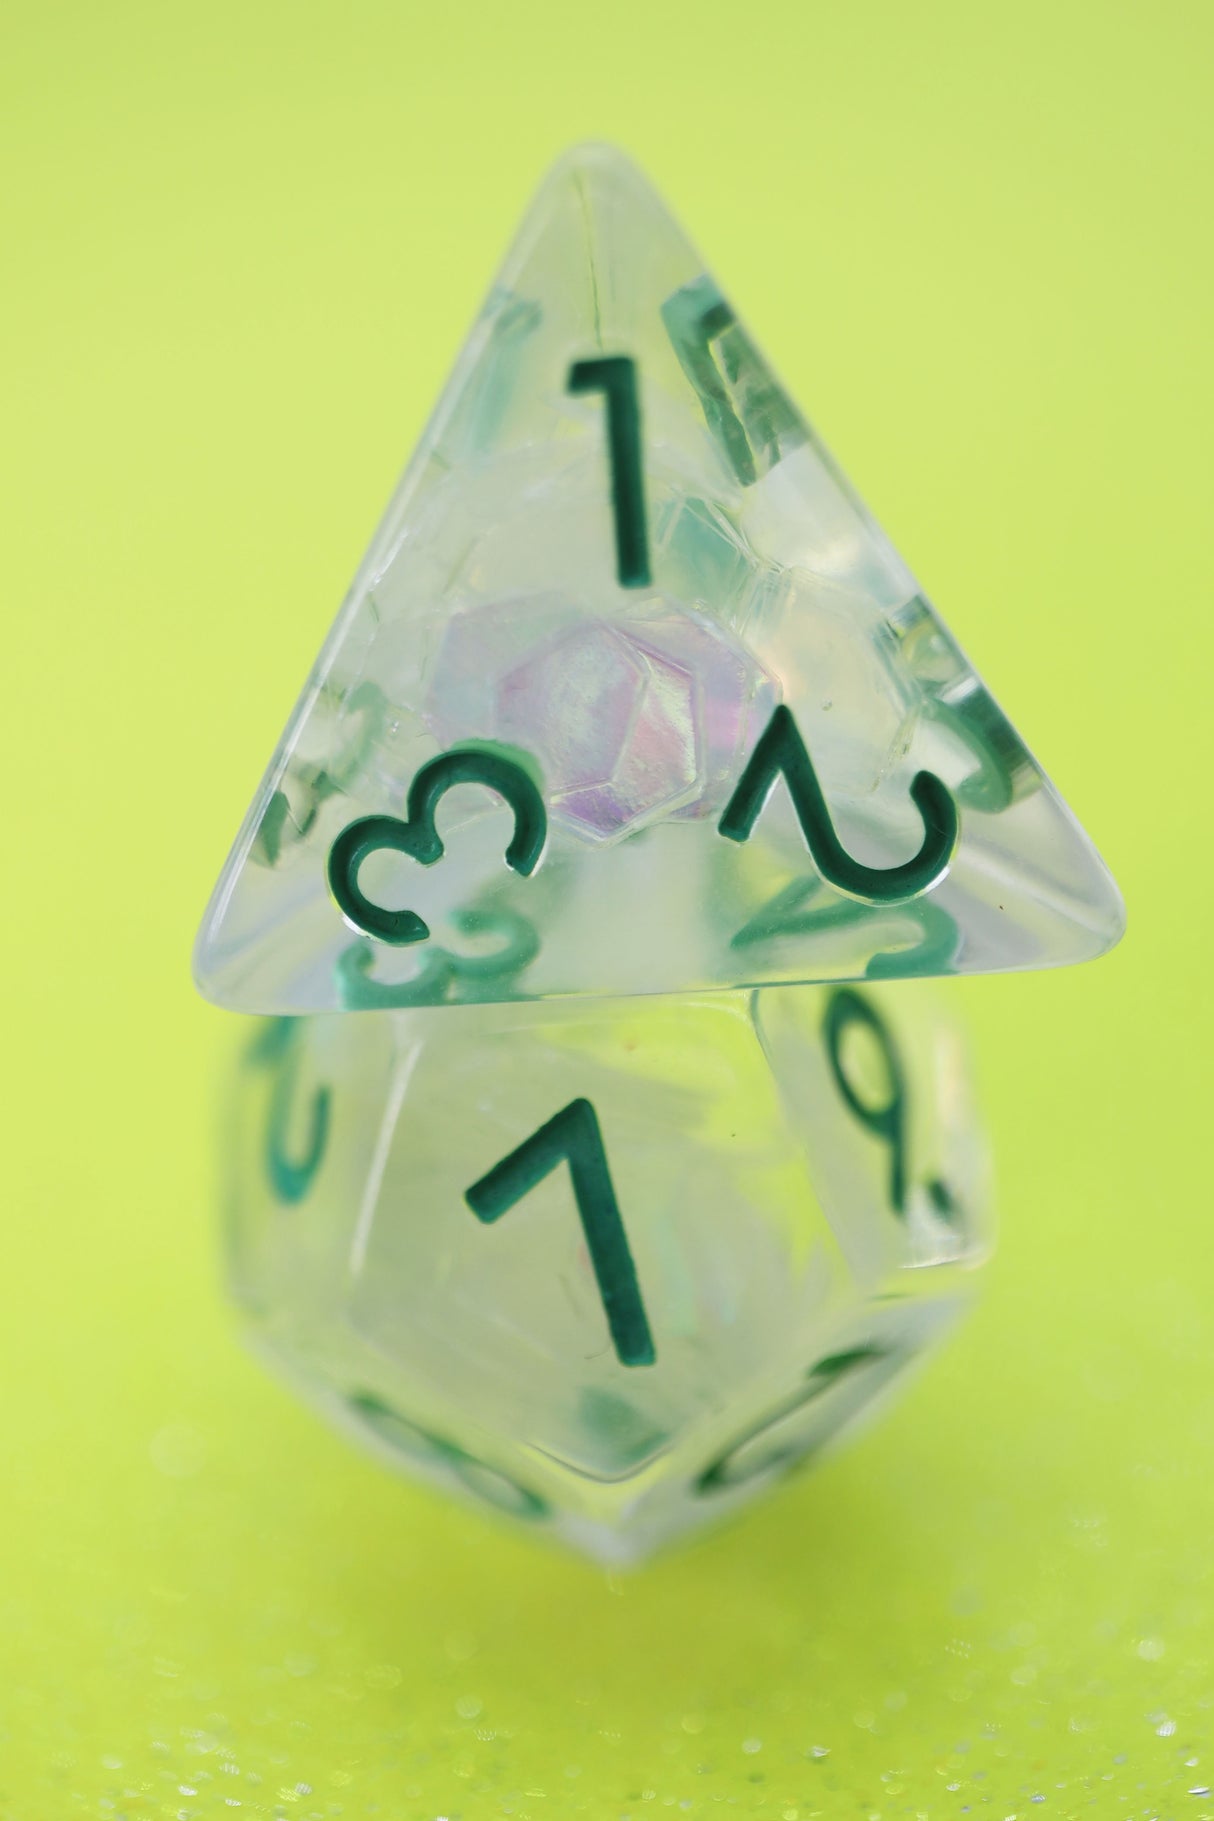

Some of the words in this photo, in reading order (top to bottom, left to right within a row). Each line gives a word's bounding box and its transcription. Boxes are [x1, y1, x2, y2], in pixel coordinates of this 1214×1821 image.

[567, 356, 650, 588] 1
[328, 748, 547, 944] 3
[717, 704, 958, 903] 2
[465, 1097, 656, 1367] 7
